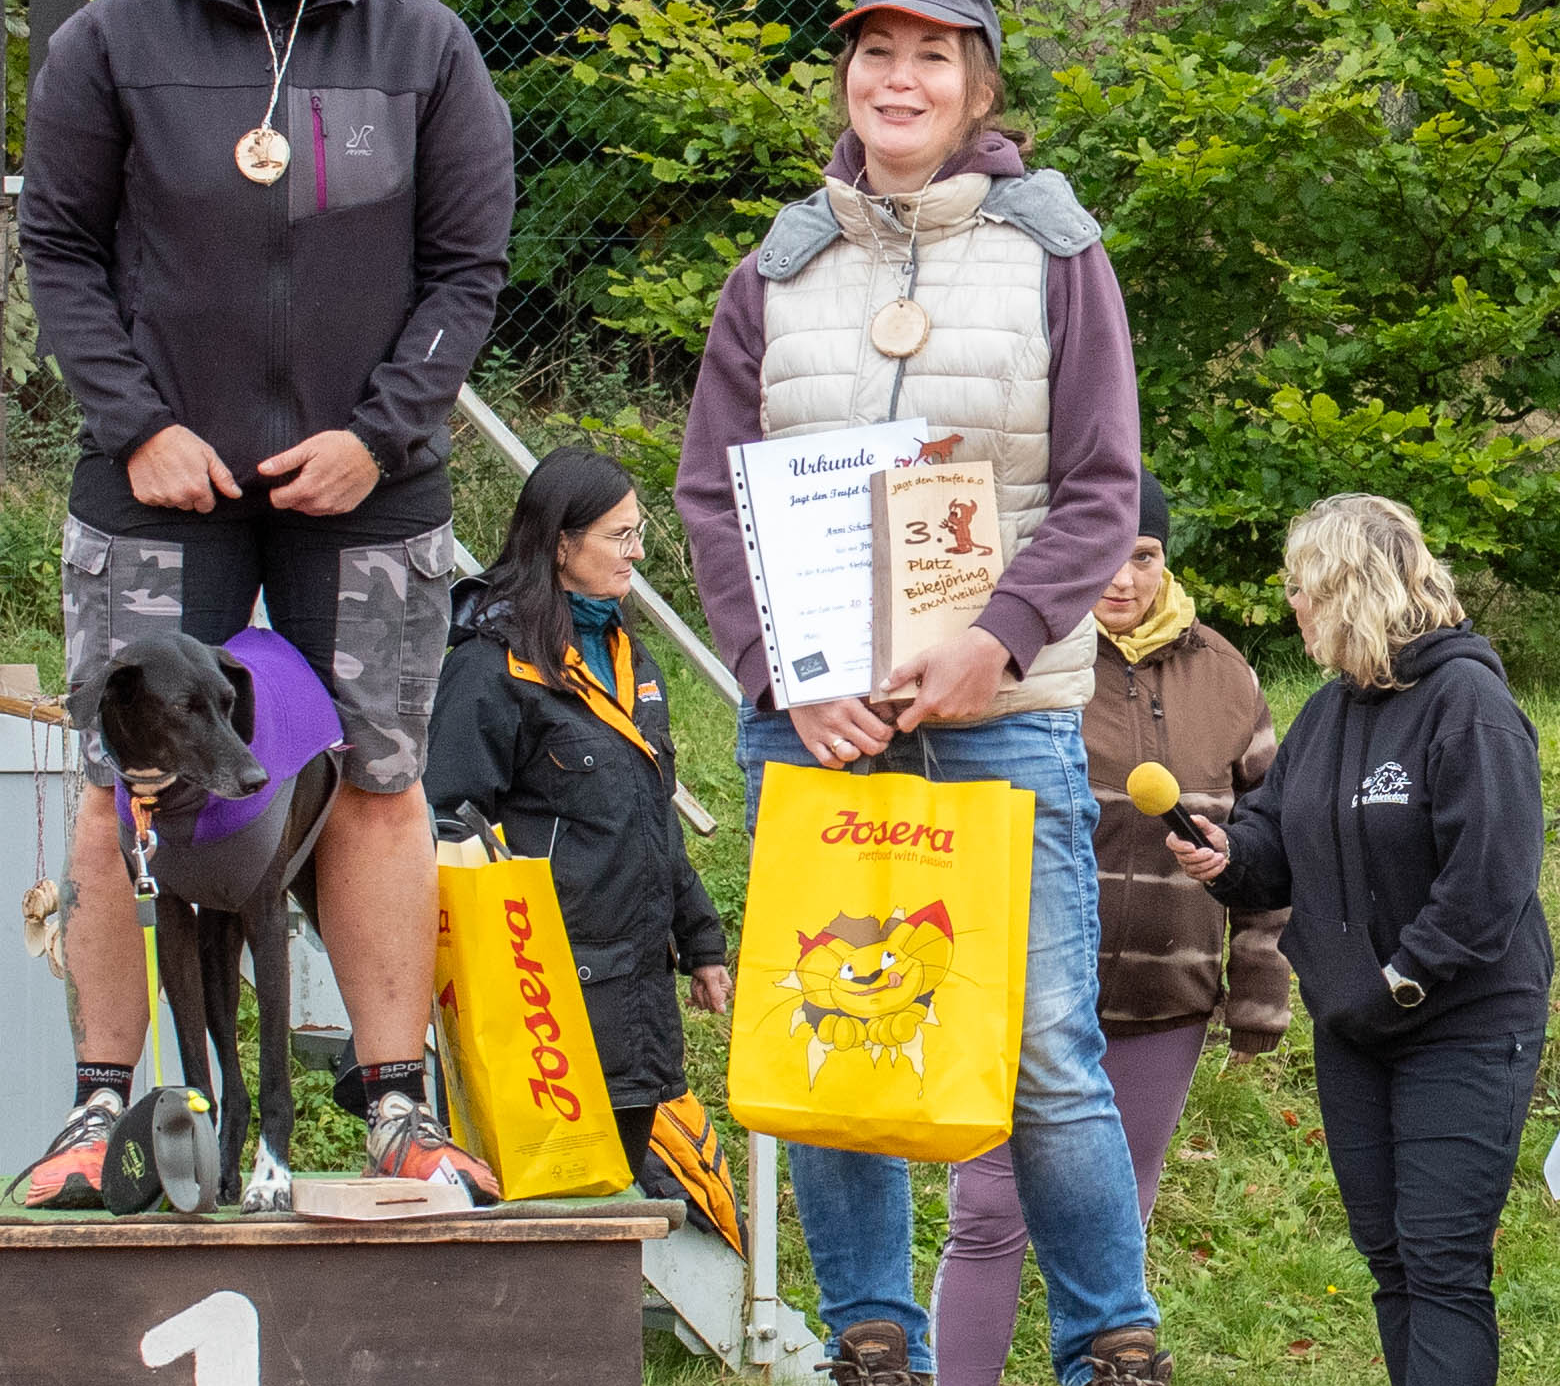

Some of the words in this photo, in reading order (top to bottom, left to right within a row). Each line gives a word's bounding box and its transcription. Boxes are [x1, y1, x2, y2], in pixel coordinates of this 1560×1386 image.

[789, 448, 875, 476] Urkunde
[891, 480, 913, 495] Jagt
[915, 477, 934, 486] den
[936, 474, 965, 486] Teufel
[967, 477, 984, 485] 6.0
[790, 494, 810, 507] Jagt
[812, 491, 828, 501] den
[905, 521, 943, 545] 3.
[907, 558, 953, 572] Platz
[904, 567, 990, 600] Bikejöring
[950, 581, 995, 603] weiblich
[821, 810, 955, 853] Josera
[858, 849, 892, 862] petfood
[894, 850, 918, 862] with
[919, 854, 953, 869] passion
[504, 897, 581, 1122] Josera
